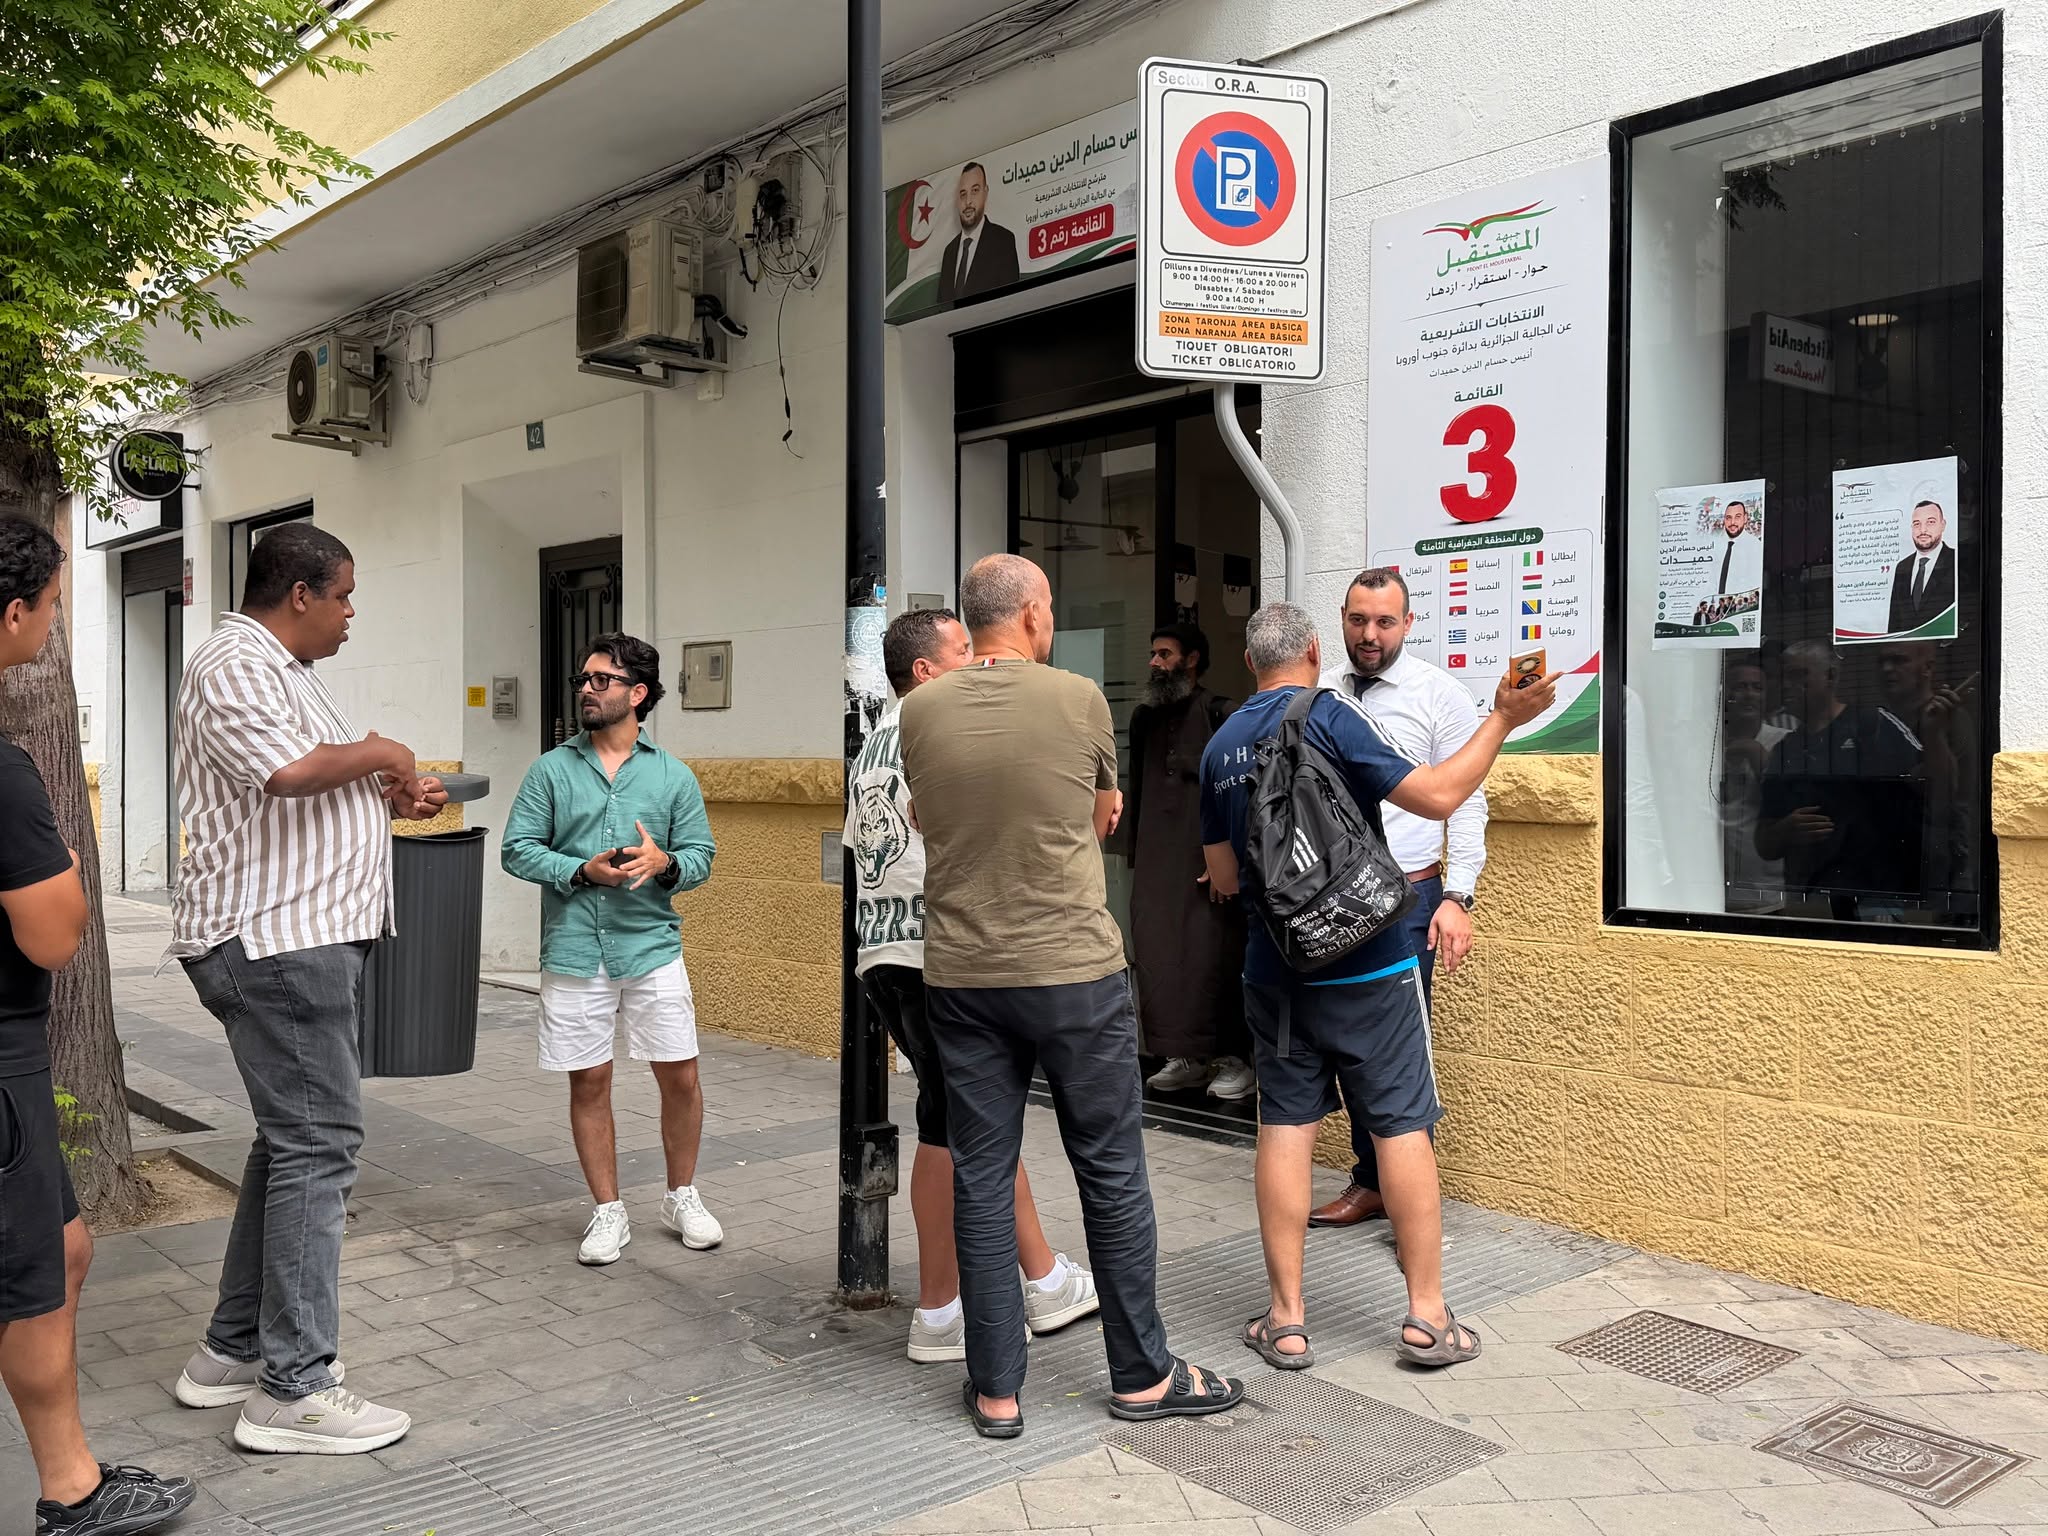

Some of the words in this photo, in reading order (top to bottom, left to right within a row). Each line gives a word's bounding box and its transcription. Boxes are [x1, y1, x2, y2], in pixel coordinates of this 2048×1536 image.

[1214, 77, 1260, 94] O.R.A.
[1050, 140, 1080, 173] الدين
[1083, 134, 1116, 165] حسام
[1002, 160, 1046, 185] حميدات
[1071, 211, 1106, 237] القائمة
[1037, 228, 1047, 253] 3
[1050, 225, 1069, 250] رقم
[1496, 231, 1521, 243] جبهة
[1436, 226, 1540, 278] المستقبل
[1164, 262, 1192, 271] Dilluns
[1275, 270, 1304, 279] Viernes
[1521, 264, 1548, 279] حوار
[1468, 269, 1511, 291] استقرار
[1194, 283, 1233, 293] Dissabtes
[1425, 281, 1458, 301] ازدهار
[1165, 314, 1191, 324] ZONA
[1195, 317, 1237, 328] TARONJA
[1485, 305, 1545, 328] الانتخابات
[1165, 325, 1191, 335] ZONA
[1195, 328, 1238, 338] NARANJA
[1420, 319, 1483, 344] التشريعية
[1522, 323, 1554, 341] الجالية
[1556, 322, 1573, 335] عن
[1480, 331, 1520, 349] الجزائرية
[1176, 340, 1218, 352] TIQUET
[1224, 344, 1293, 357] OBLIGATORI
[1422, 348, 1449, 362] جنوب
[1451, 341, 1478, 356] بدائرة
[1510, 347, 1534, 364] أنيس
[1171, 354, 1213, 366] TICKET
[1218, 357, 1297, 371] OBLIGATORIO
[1395, 348, 1420, 367] أوروبا
[1484, 357, 1509, 371] حسام
[1428, 366, 1460, 378] حميدات
[1461, 360, 1482, 375] الدين
[1454, 383, 1503, 404] القائمة
[530, 426, 542, 445] 42
[1439, 403, 1518, 523] 3
[1447, 536, 1483, 550] الجغرافية
[1484, 533, 1517, 546] المنطقة
[1519, 532, 1536, 544] دول
[1421, 540, 1446, 552] الثامنة
[1475, 558, 1500, 569] إسبانيا
[1551, 550, 1577, 562] إيطاليا
[1405, 565, 1433, 577] البرتغال
[1475, 581, 1500, 592] النمسا
[1551, 574, 1576, 586] المجر
[1547, 595, 1578, 605] البوسنة
[1475, 607, 1500, 617] صربيا
[1546, 607, 1579, 618] والهرسك
[1474, 630, 1500, 642] اليونان
[1549, 625, 1576, 637] رومانيا
[1474, 655, 1499, 665] تركيا
[1214, 774, 1237, 796] Sport
